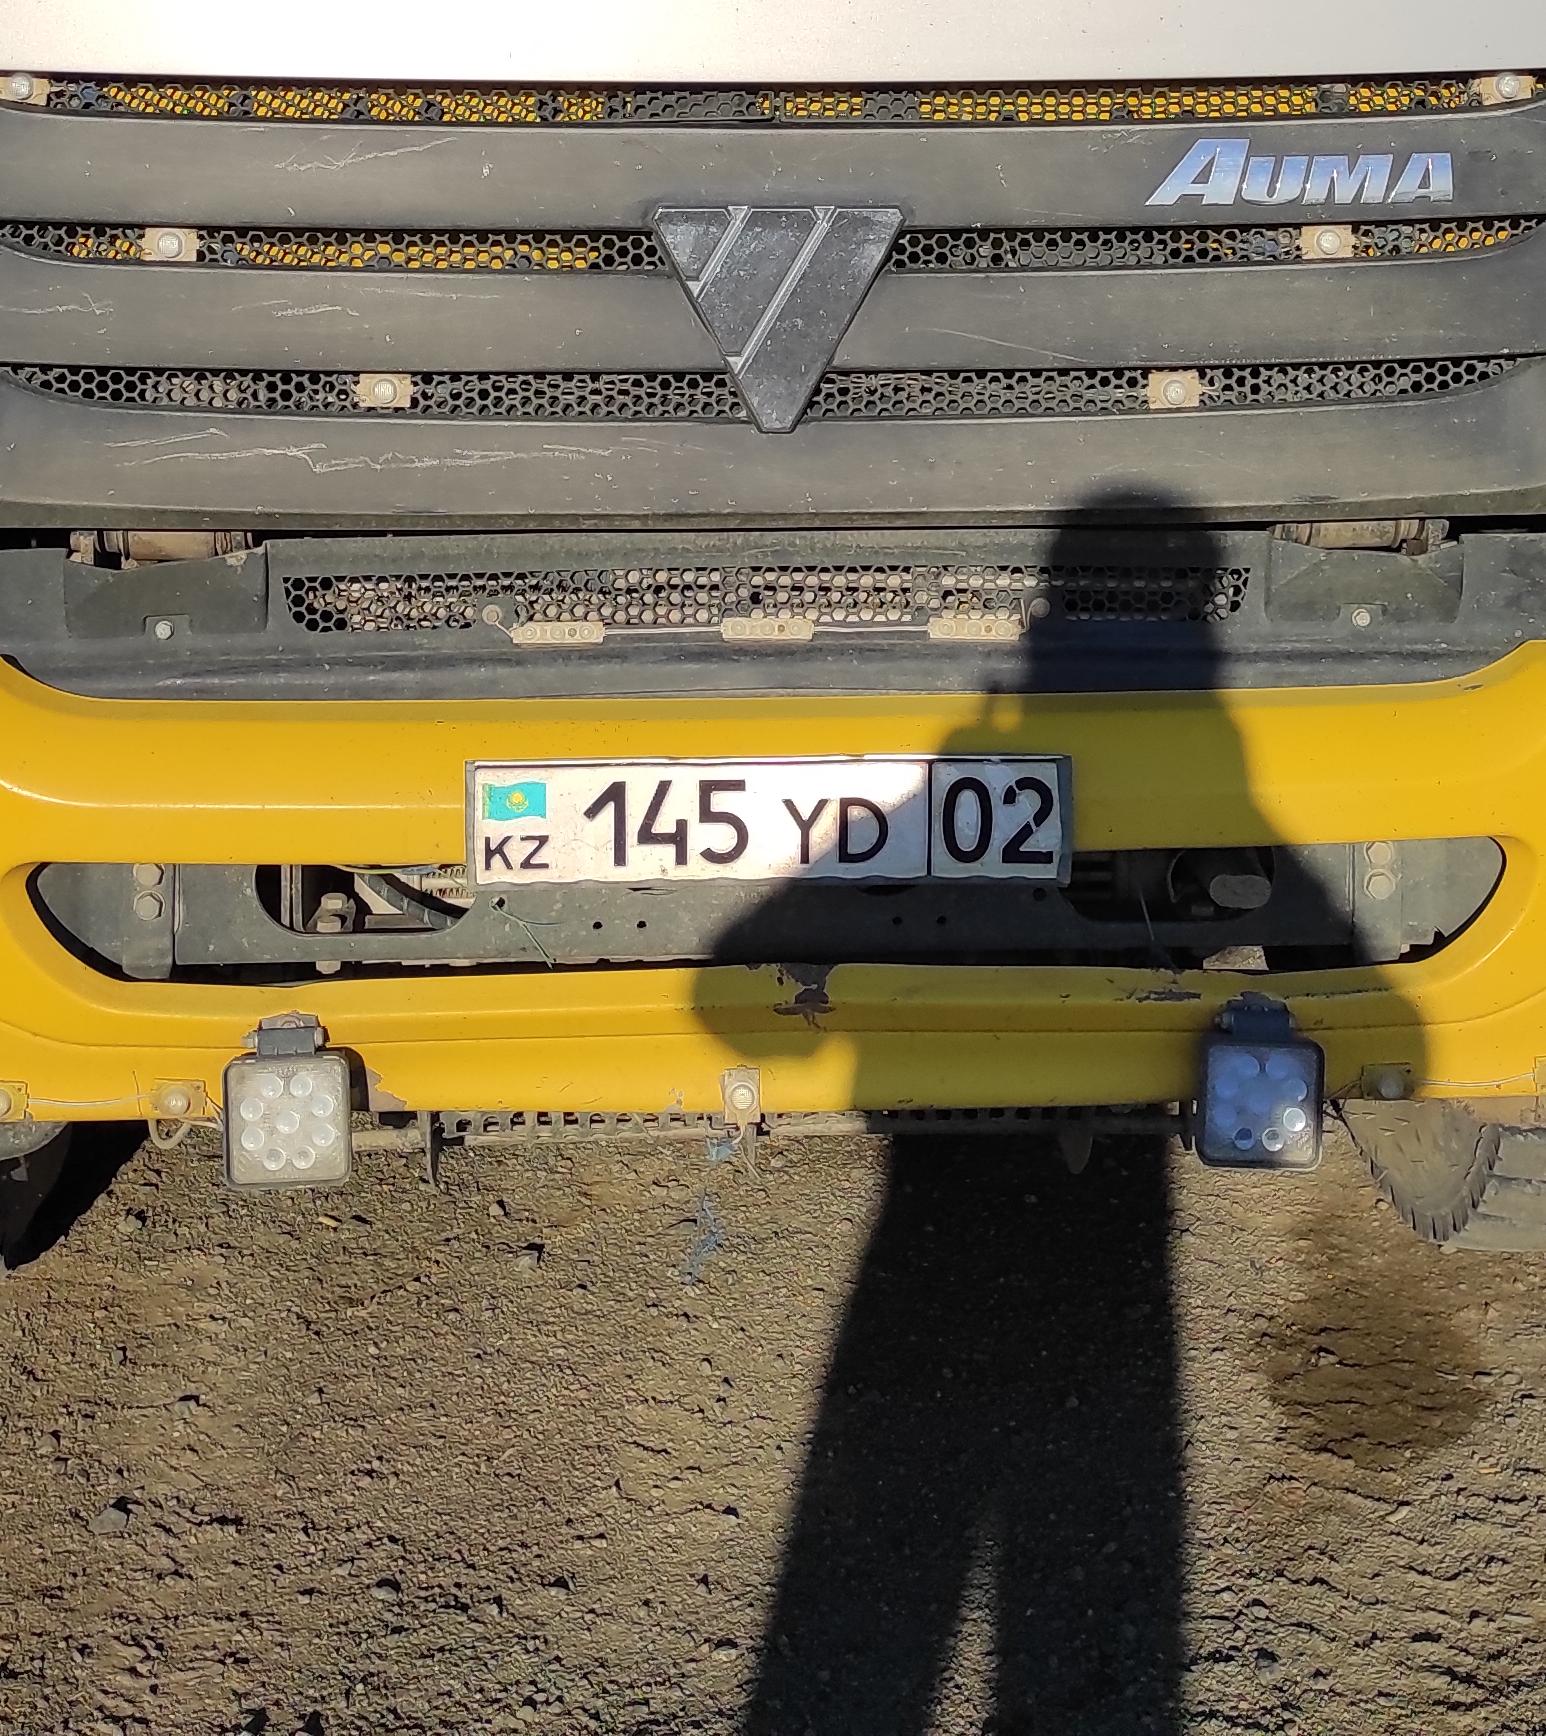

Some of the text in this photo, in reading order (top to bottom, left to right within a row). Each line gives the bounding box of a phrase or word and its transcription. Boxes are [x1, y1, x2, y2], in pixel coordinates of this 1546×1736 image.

[583, 775, 1055, 866] 145 YD 02
[484, 835, 550, 870] KZ
